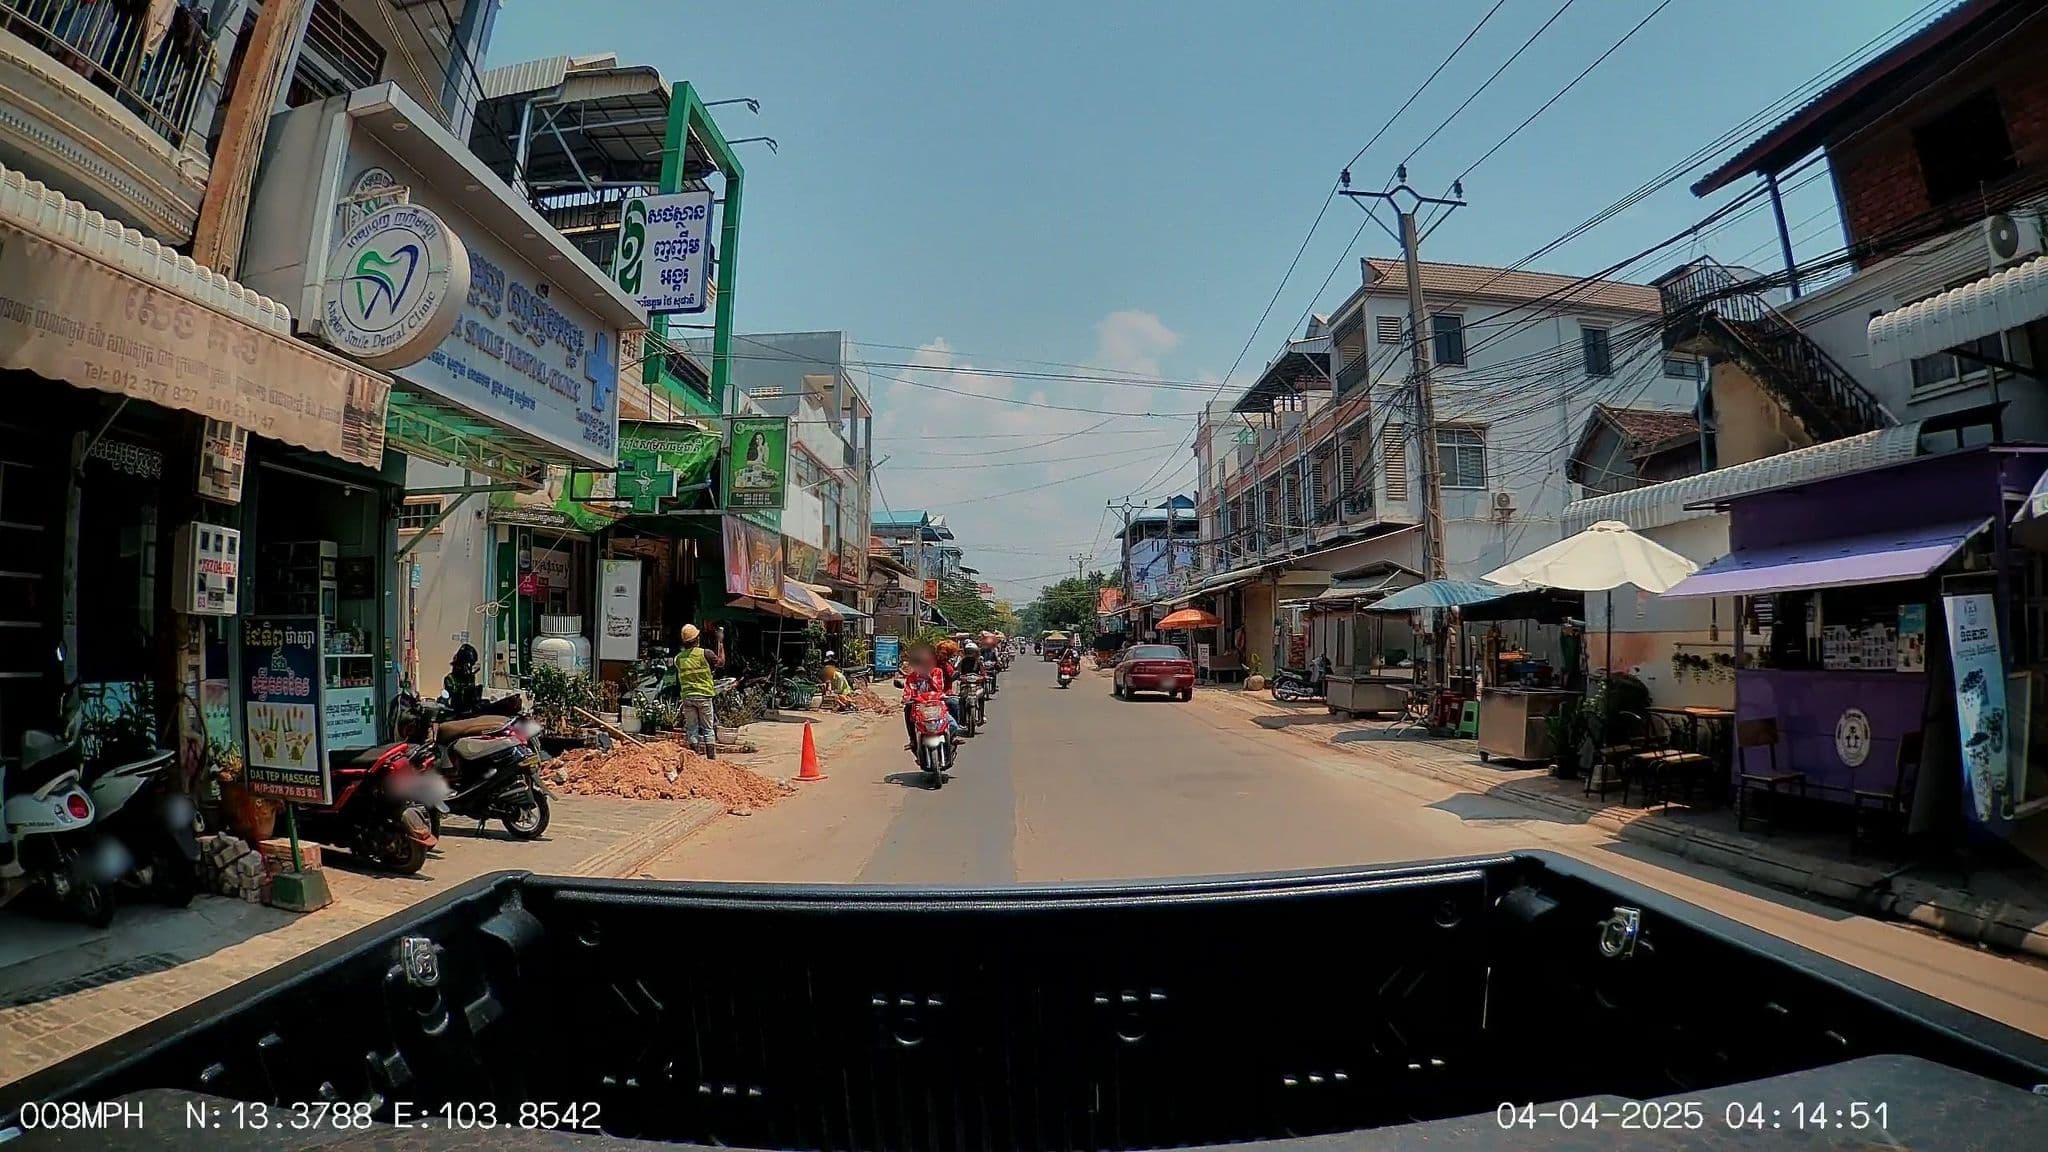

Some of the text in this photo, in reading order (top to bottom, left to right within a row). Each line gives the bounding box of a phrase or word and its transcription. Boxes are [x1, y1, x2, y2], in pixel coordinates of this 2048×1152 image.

[654, 230, 700, 262] ញញឹម
[660, 268, 689, 292] អង្គរ
[328, 300, 345, 336] Angkor
[345, 331, 369, 348] Smile
[372, 323, 406, 348] Dental
[408, 291, 436, 329] Clinic
[112, 369, 138, 391] 012
[143, 378, 169, 398] 377
[250, 769, 320, 786] DAI TEP MASSAGE
